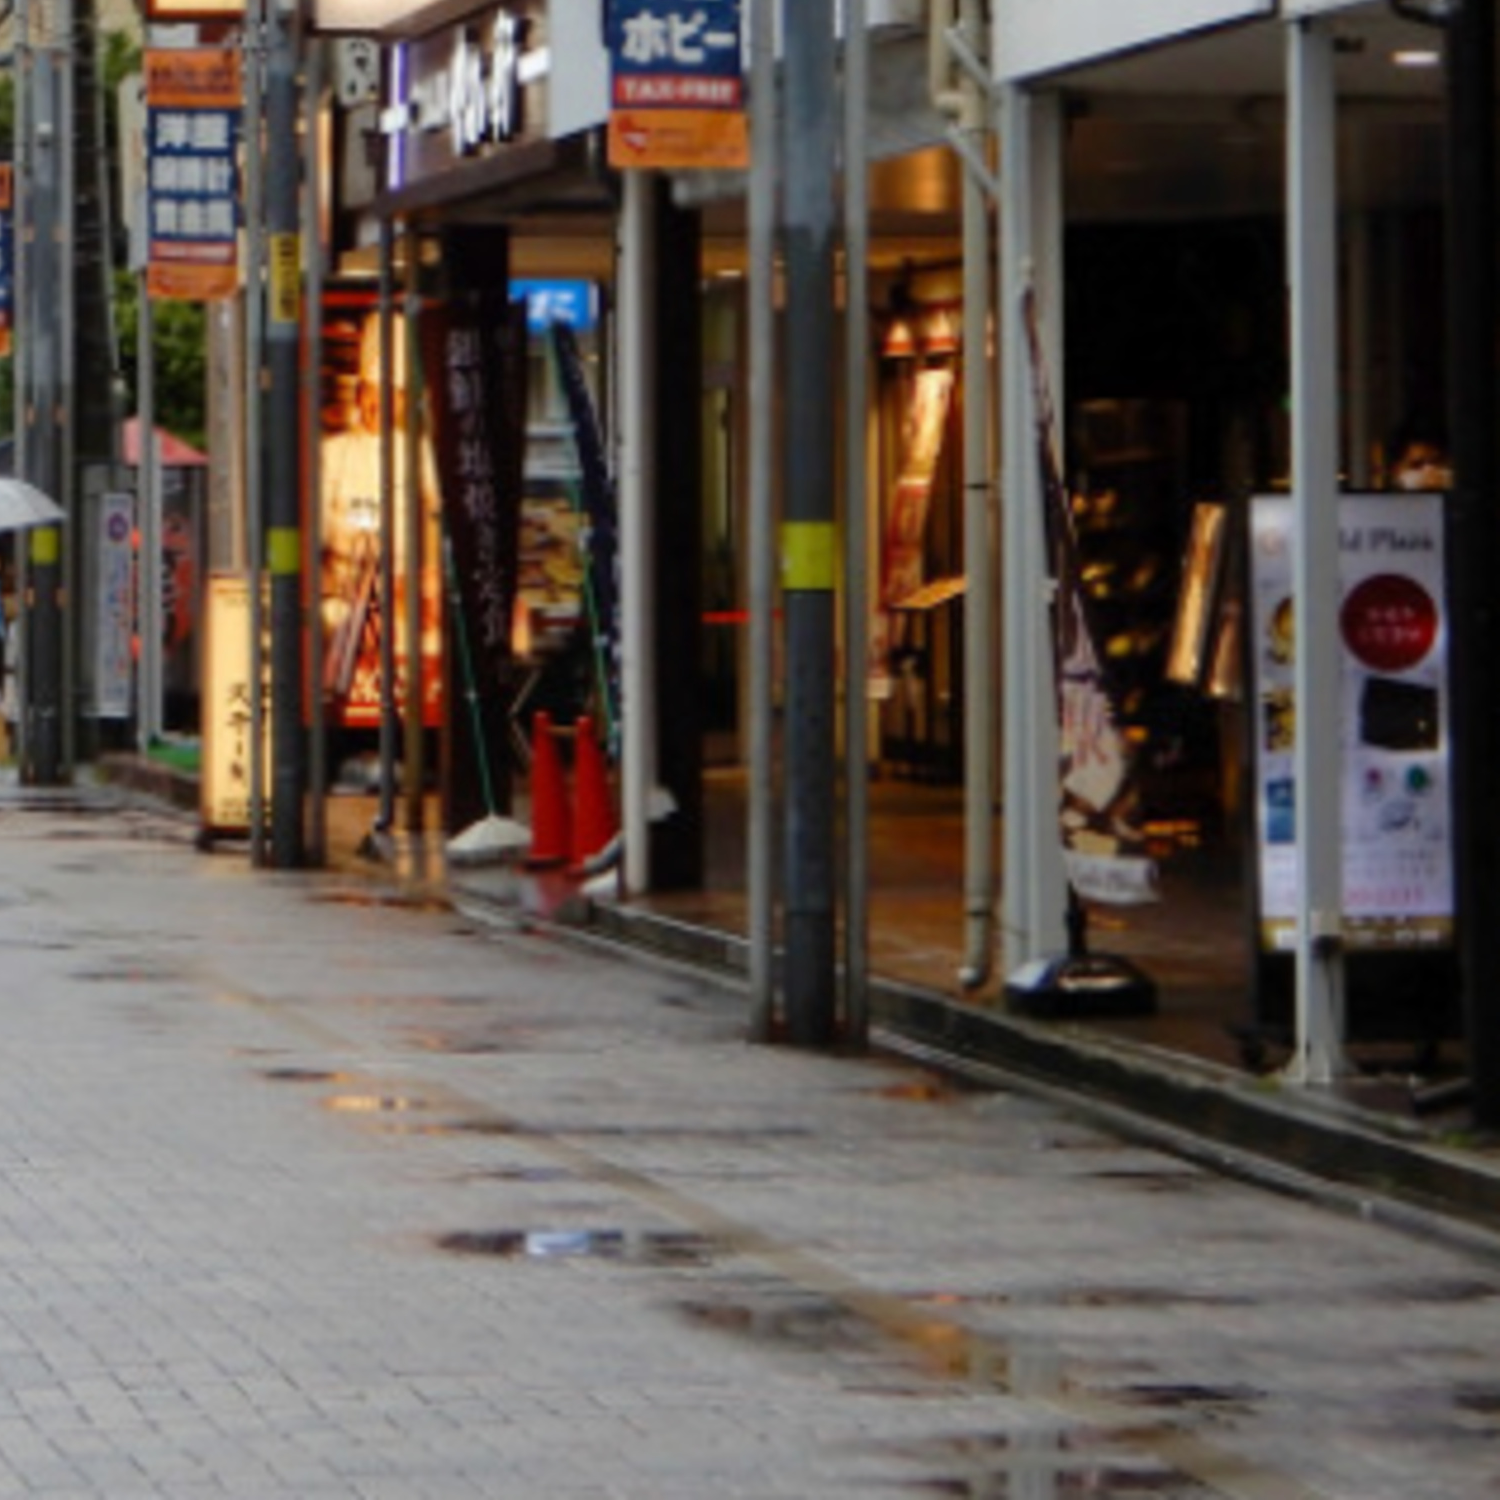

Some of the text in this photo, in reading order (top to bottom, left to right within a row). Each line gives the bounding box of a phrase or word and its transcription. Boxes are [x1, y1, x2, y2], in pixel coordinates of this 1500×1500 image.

[621, 11, 737, 65] ホビー
[623, 78, 733, 101] TAX-FREE
